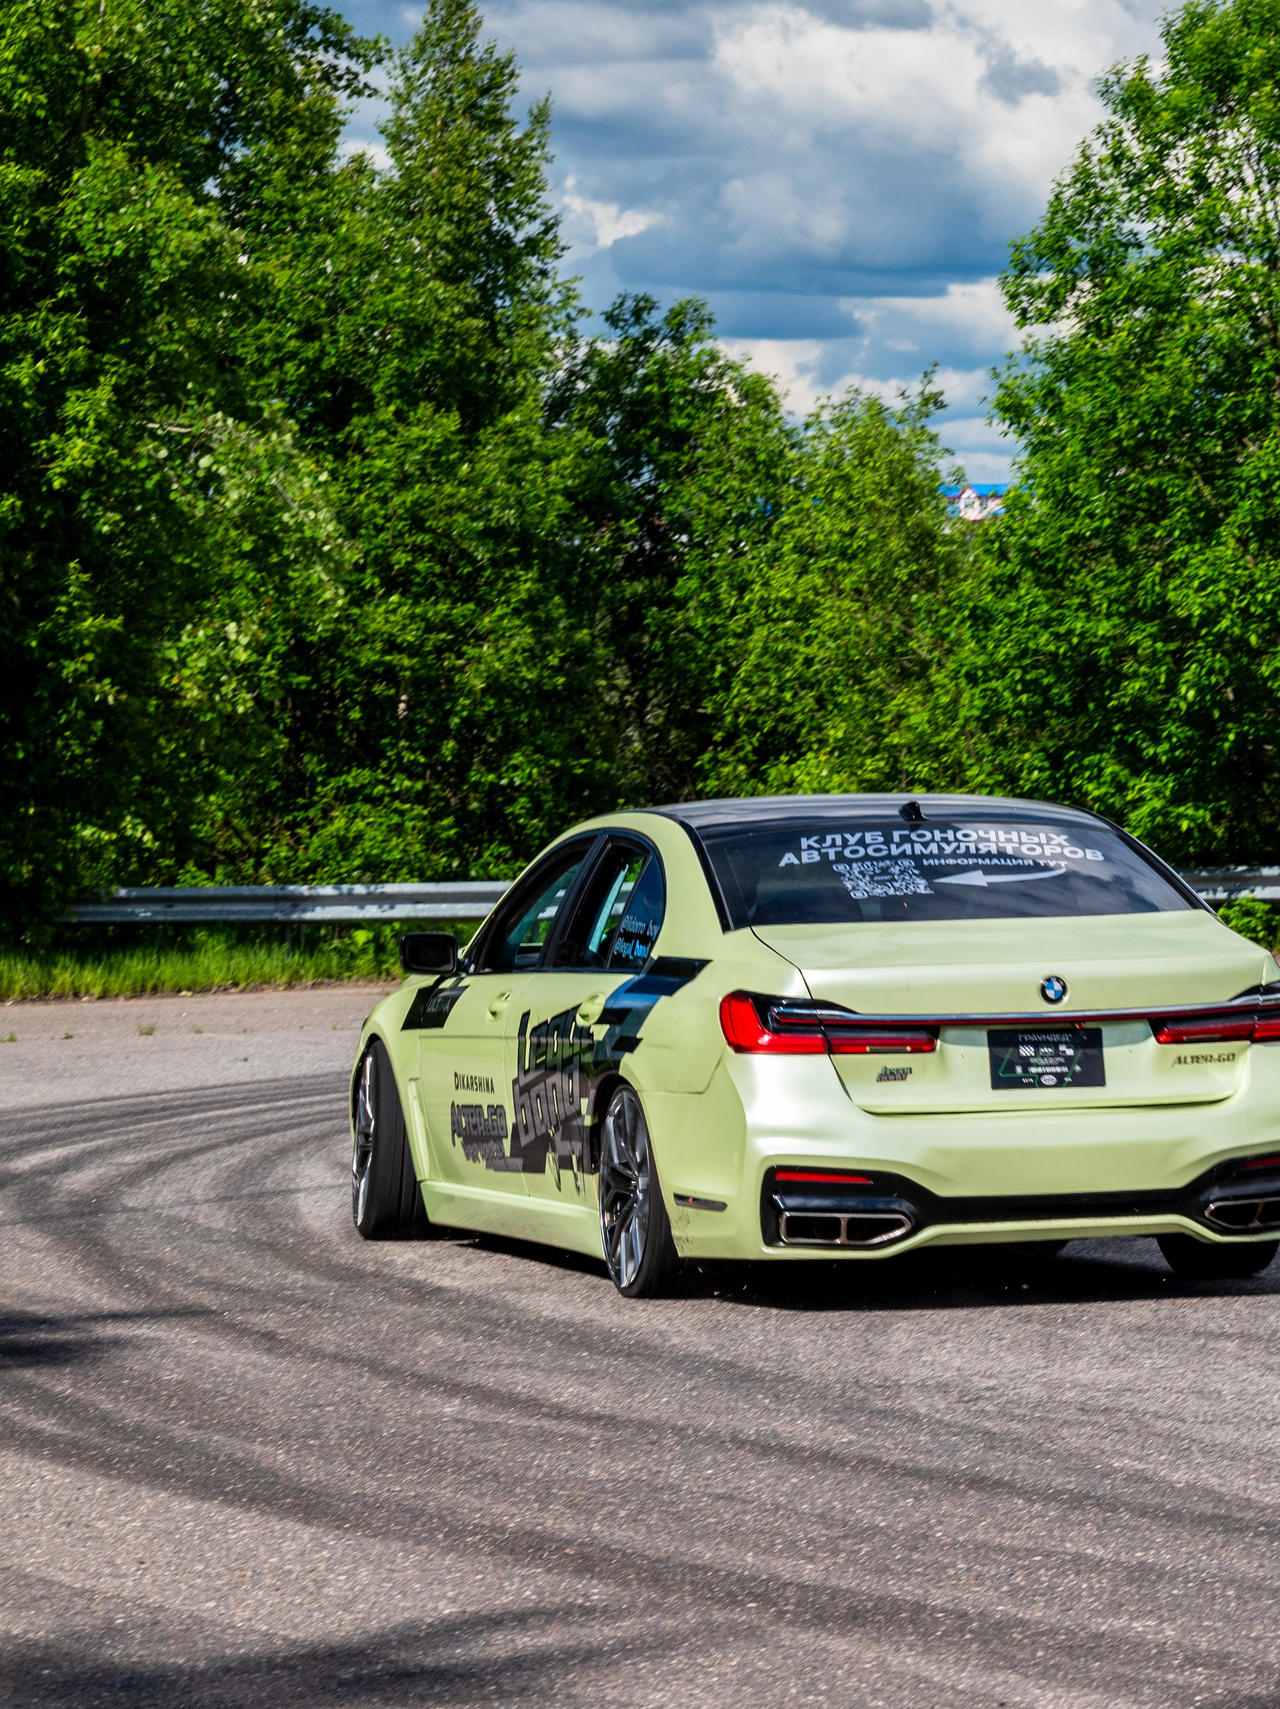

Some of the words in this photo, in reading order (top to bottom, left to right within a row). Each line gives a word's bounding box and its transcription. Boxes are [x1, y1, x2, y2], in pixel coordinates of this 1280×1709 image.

[801, 830, 885, 850] КЛУБ
[892, 829, 1070, 847] ГОНОЧНЫХ
[778, 841, 1105, 868] АВТОСИМУЛЯТОРОВ
[922, 857, 1034, 867] ИНФОРМАЦИЯ
[1035, 859, 1068, 868] ТУТ
